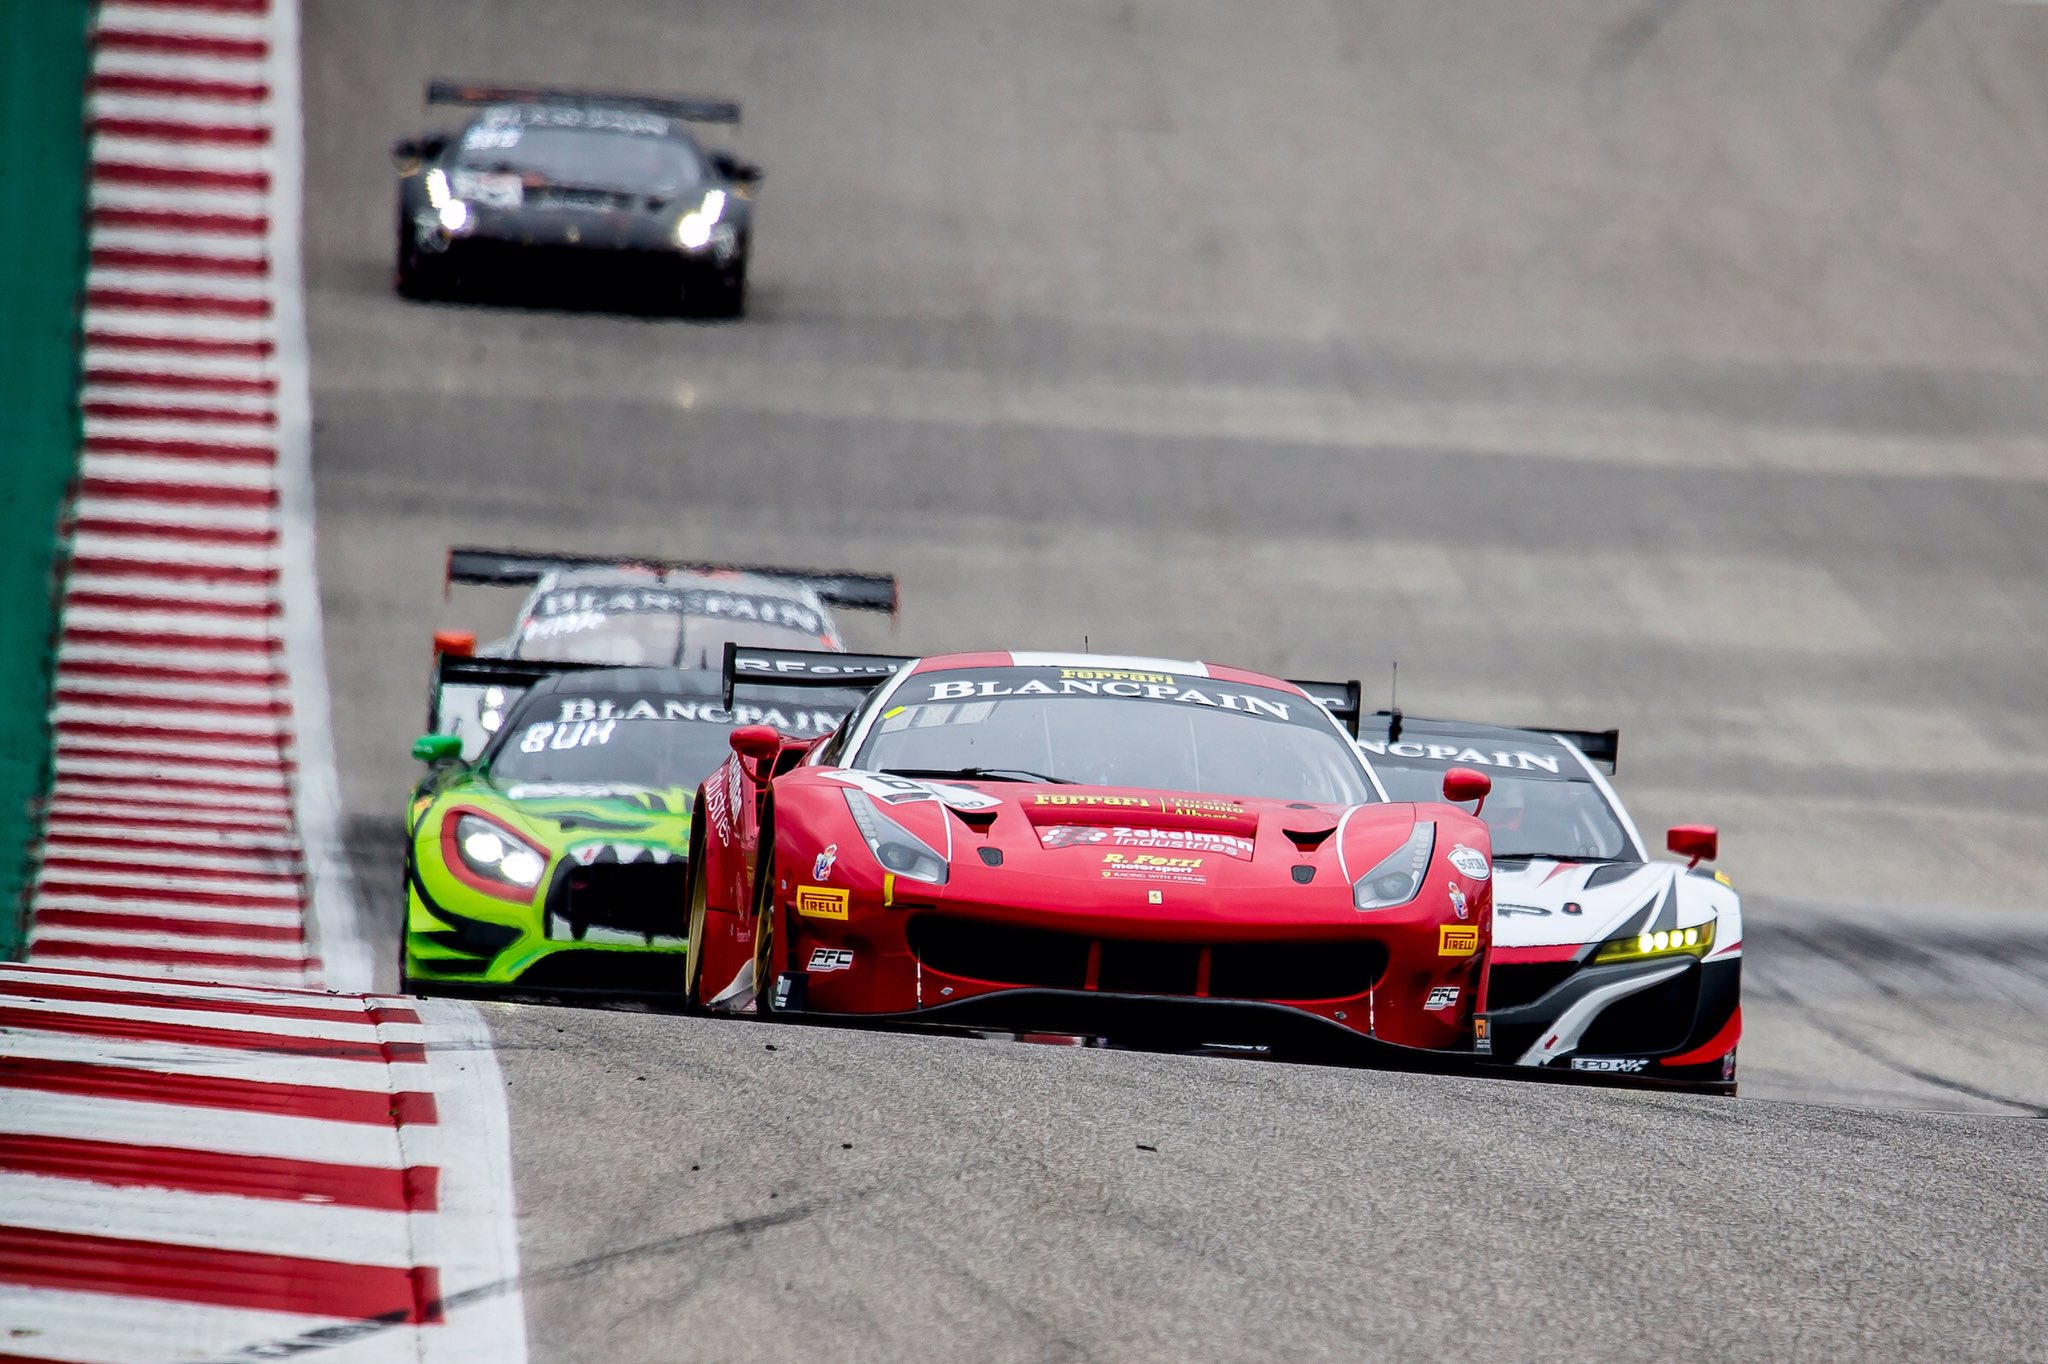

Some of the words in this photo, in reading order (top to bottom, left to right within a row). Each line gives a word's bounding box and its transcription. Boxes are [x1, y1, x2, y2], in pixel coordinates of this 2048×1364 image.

[1060, 668, 1176, 686] Ferrari
[927, 679, 1291, 721] BLANCPAIN
[1357, 739, 1560, 774] NCPAIN
[706, 767, 731, 848] ndustries
[1034, 794, 1150, 808] Ferrari
[1112, 827, 1254, 854] Zekelman
[1115, 836, 1239, 856] Industries
[1111, 863, 1193, 874] motorsport
[801, 892, 844, 914] PIRELLI
[1443, 931, 1476, 950] PIRELLI
[811, 949, 853, 965] PFC
[1428, 988, 1459, 1002] PFC
